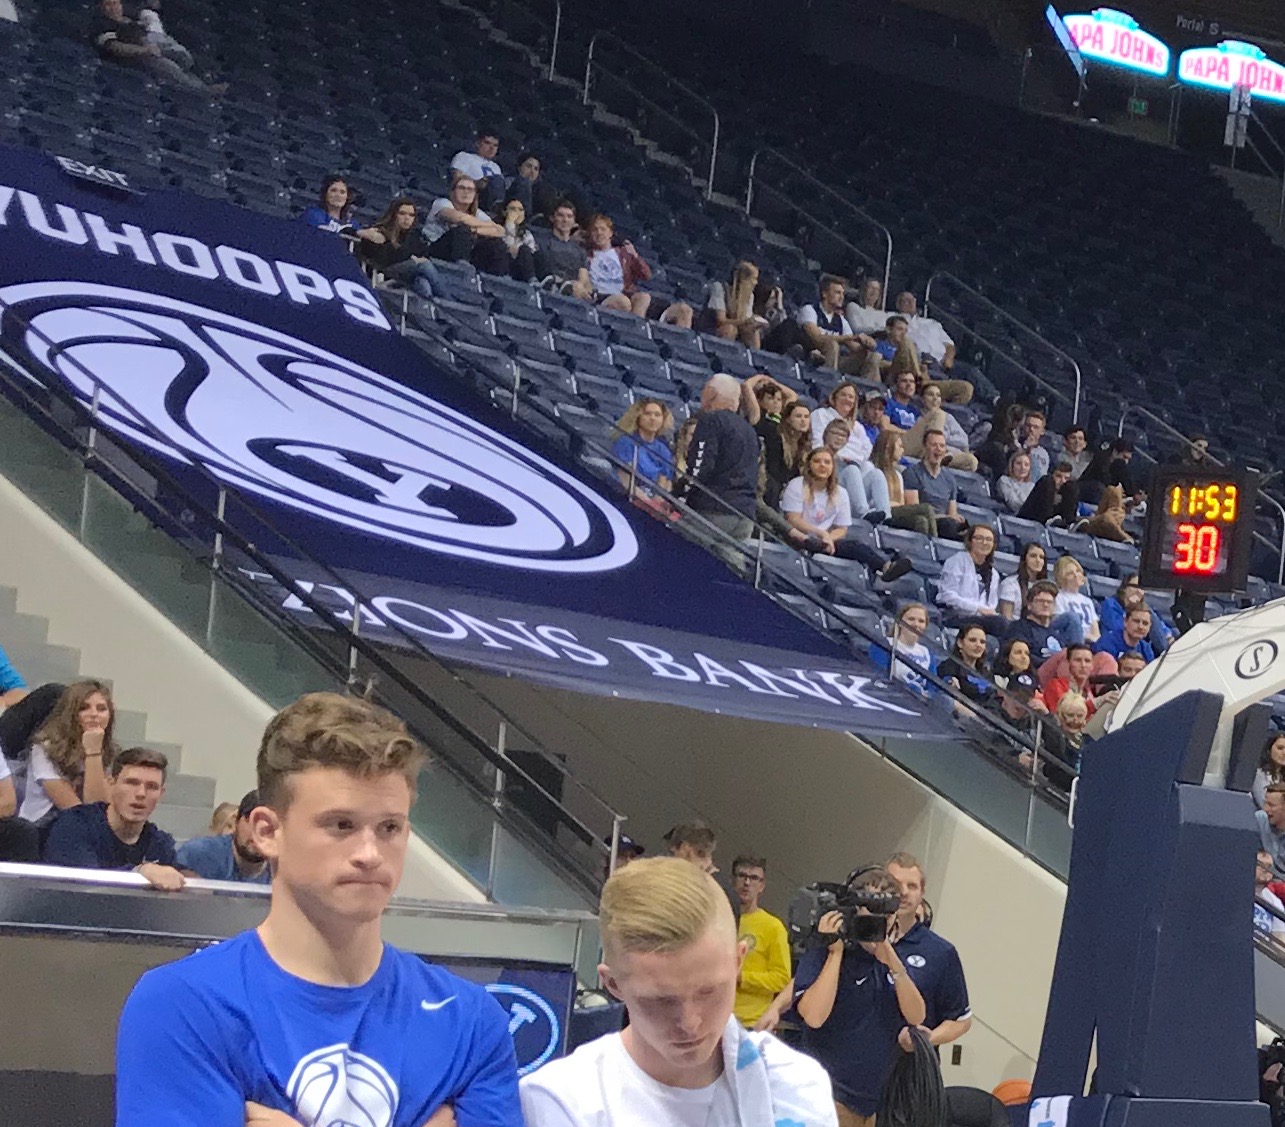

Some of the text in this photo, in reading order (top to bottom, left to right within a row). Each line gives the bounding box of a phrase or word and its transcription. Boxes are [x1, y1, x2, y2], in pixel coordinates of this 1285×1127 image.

[1068, 20, 1104, 50] APA
[55, 155, 129, 187] EXIT
[1170, 484, 1238, 522] 11:53
[1174, 524, 1219, 573] 30
[607, 636, 921, 715] BANK
